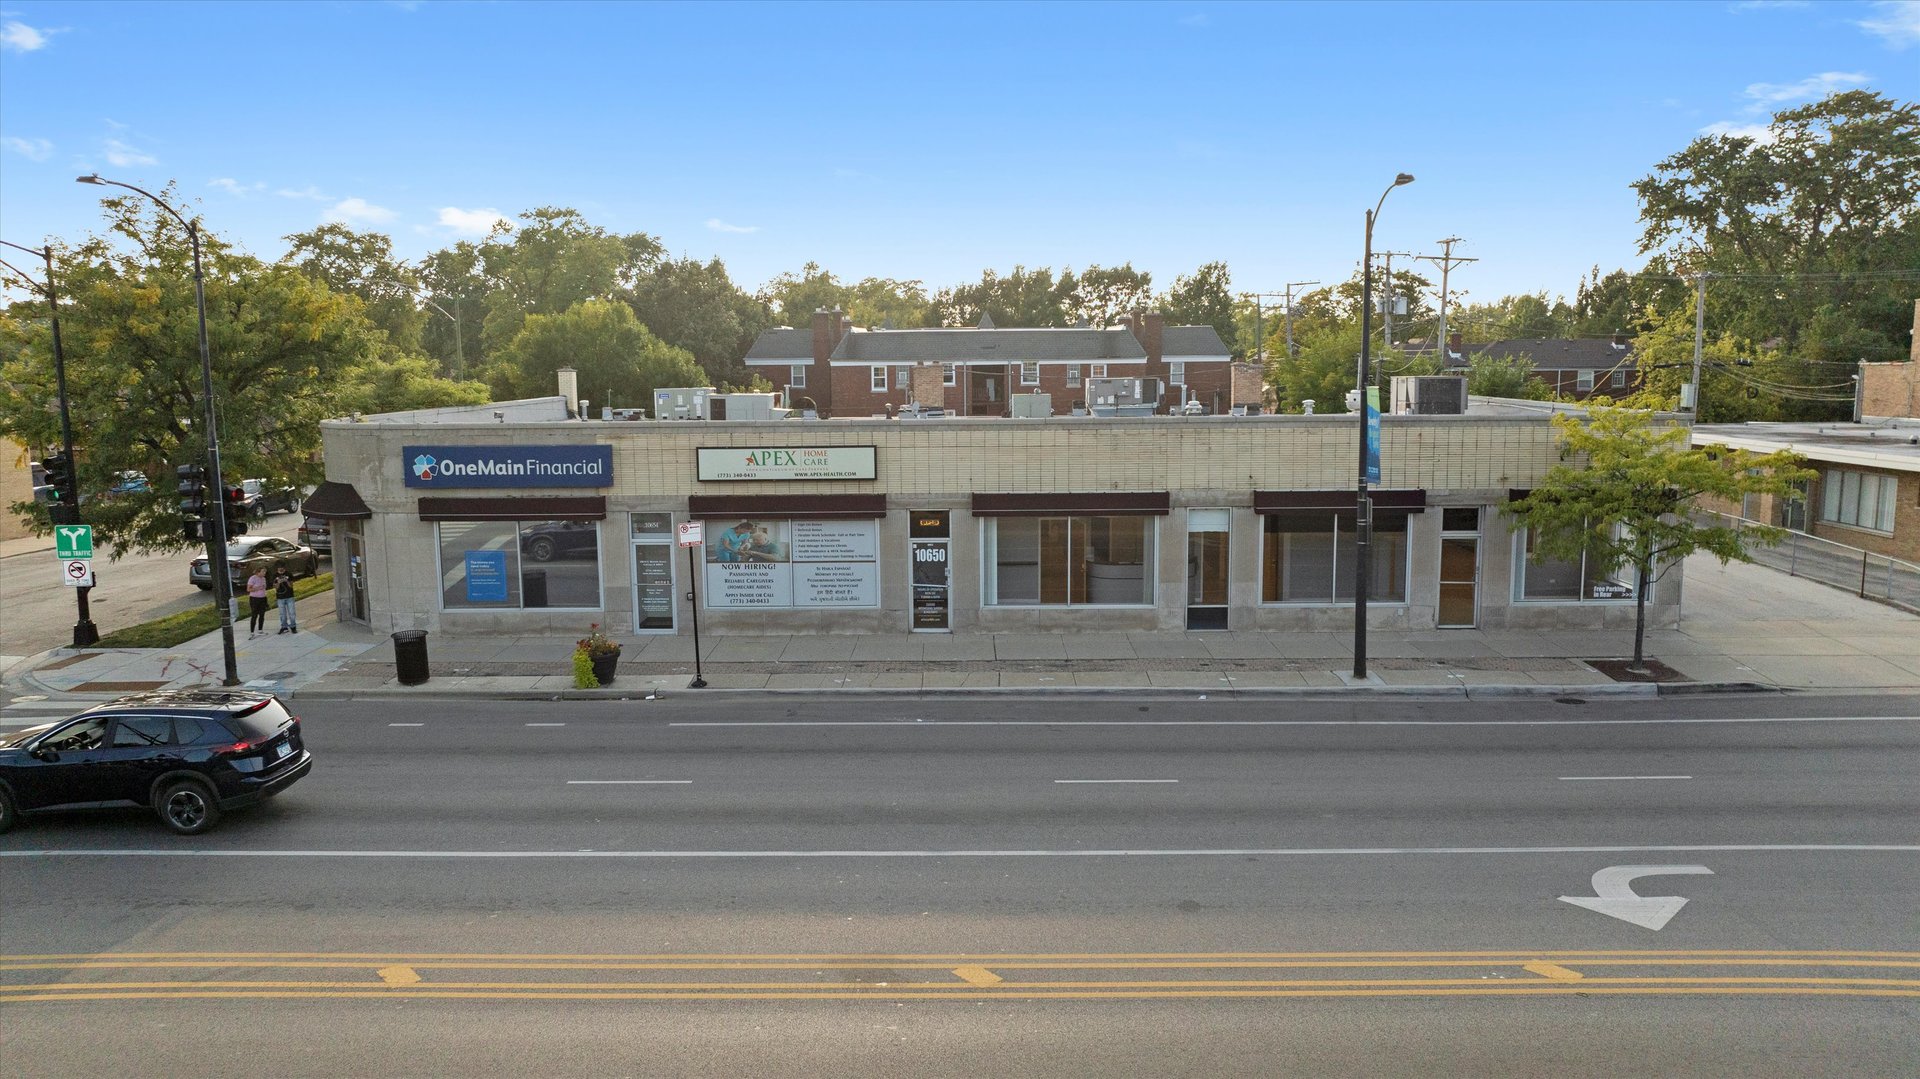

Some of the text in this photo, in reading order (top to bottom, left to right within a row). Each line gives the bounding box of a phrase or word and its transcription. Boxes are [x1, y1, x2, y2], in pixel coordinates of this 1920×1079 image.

[746, 451, 797, 466] APEX
[440, 459, 602, 476] OneMain Financial
[915, 548, 945, 562] 10650
